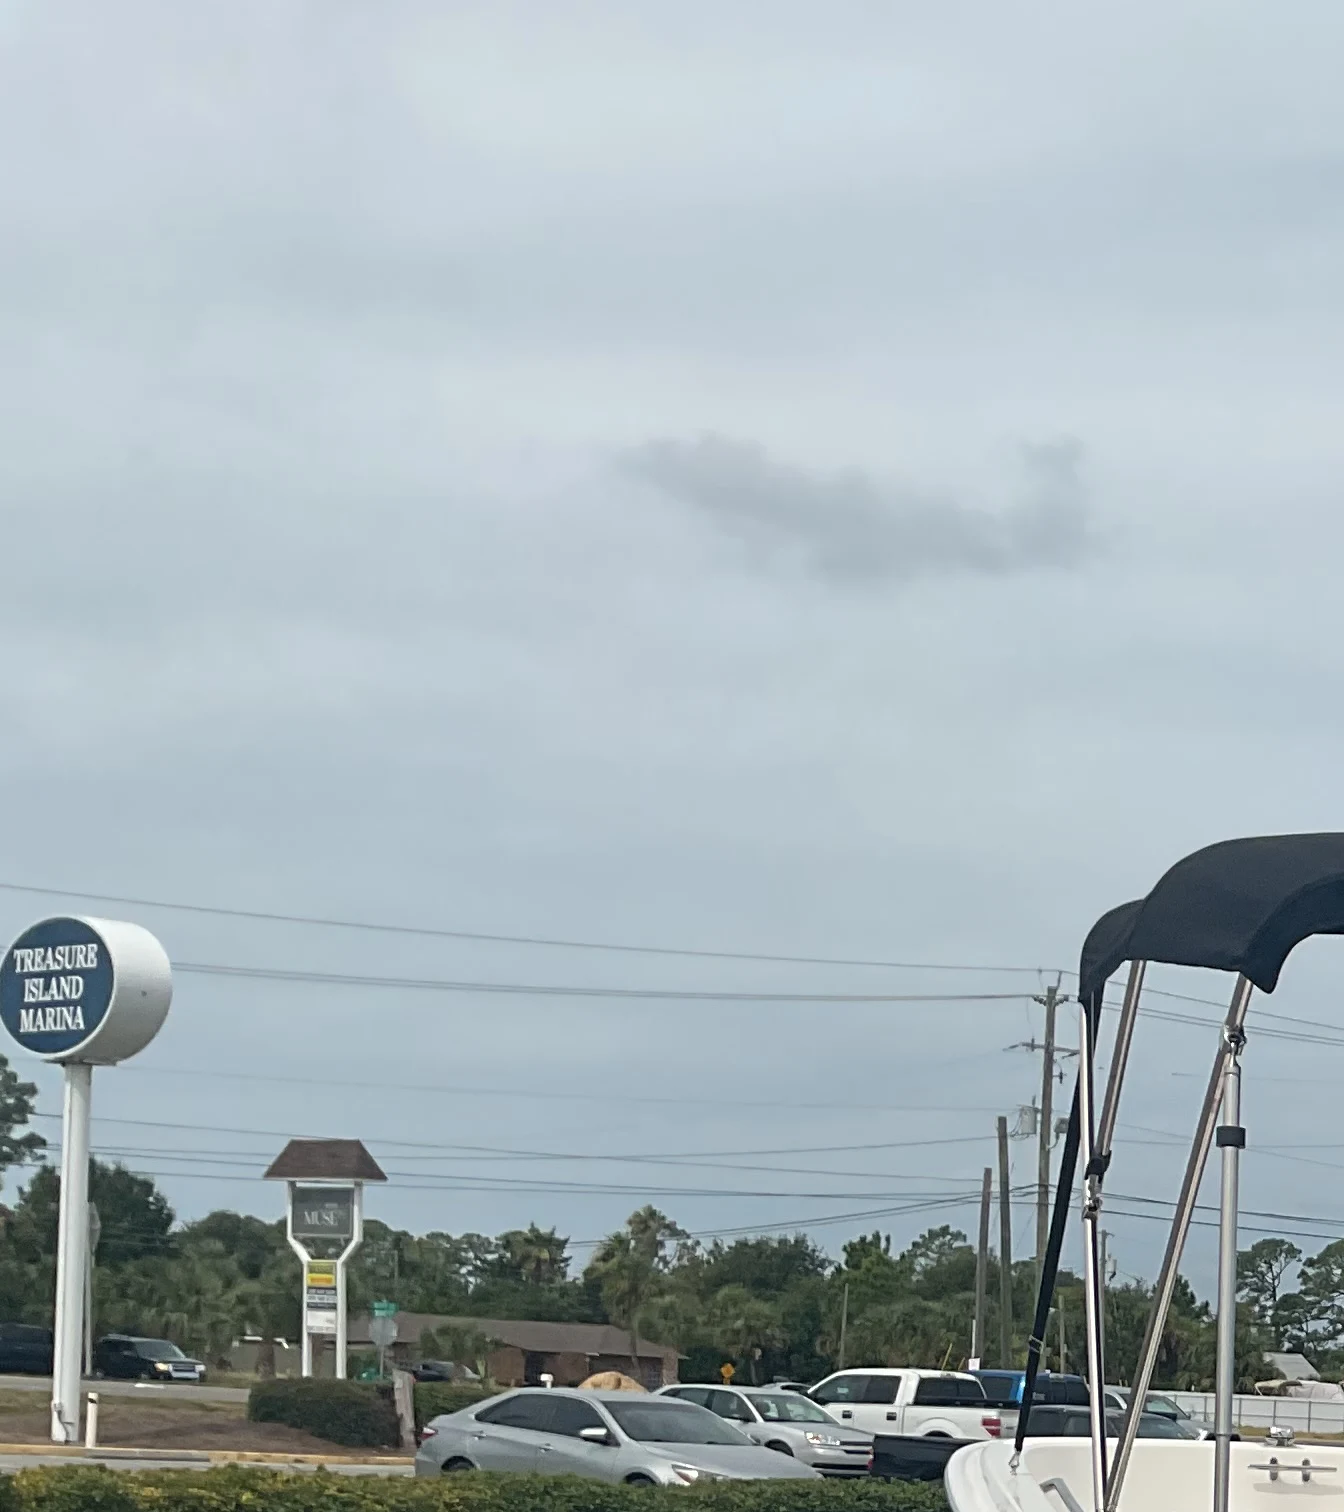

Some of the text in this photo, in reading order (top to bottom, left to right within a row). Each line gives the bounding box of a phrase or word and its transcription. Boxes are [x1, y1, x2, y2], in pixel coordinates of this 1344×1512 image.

[13, 943, 98, 973] TREASURE
[24, 976, 84, 1002] ISLAND
[19, 1006, 85, 1033] MARINA
